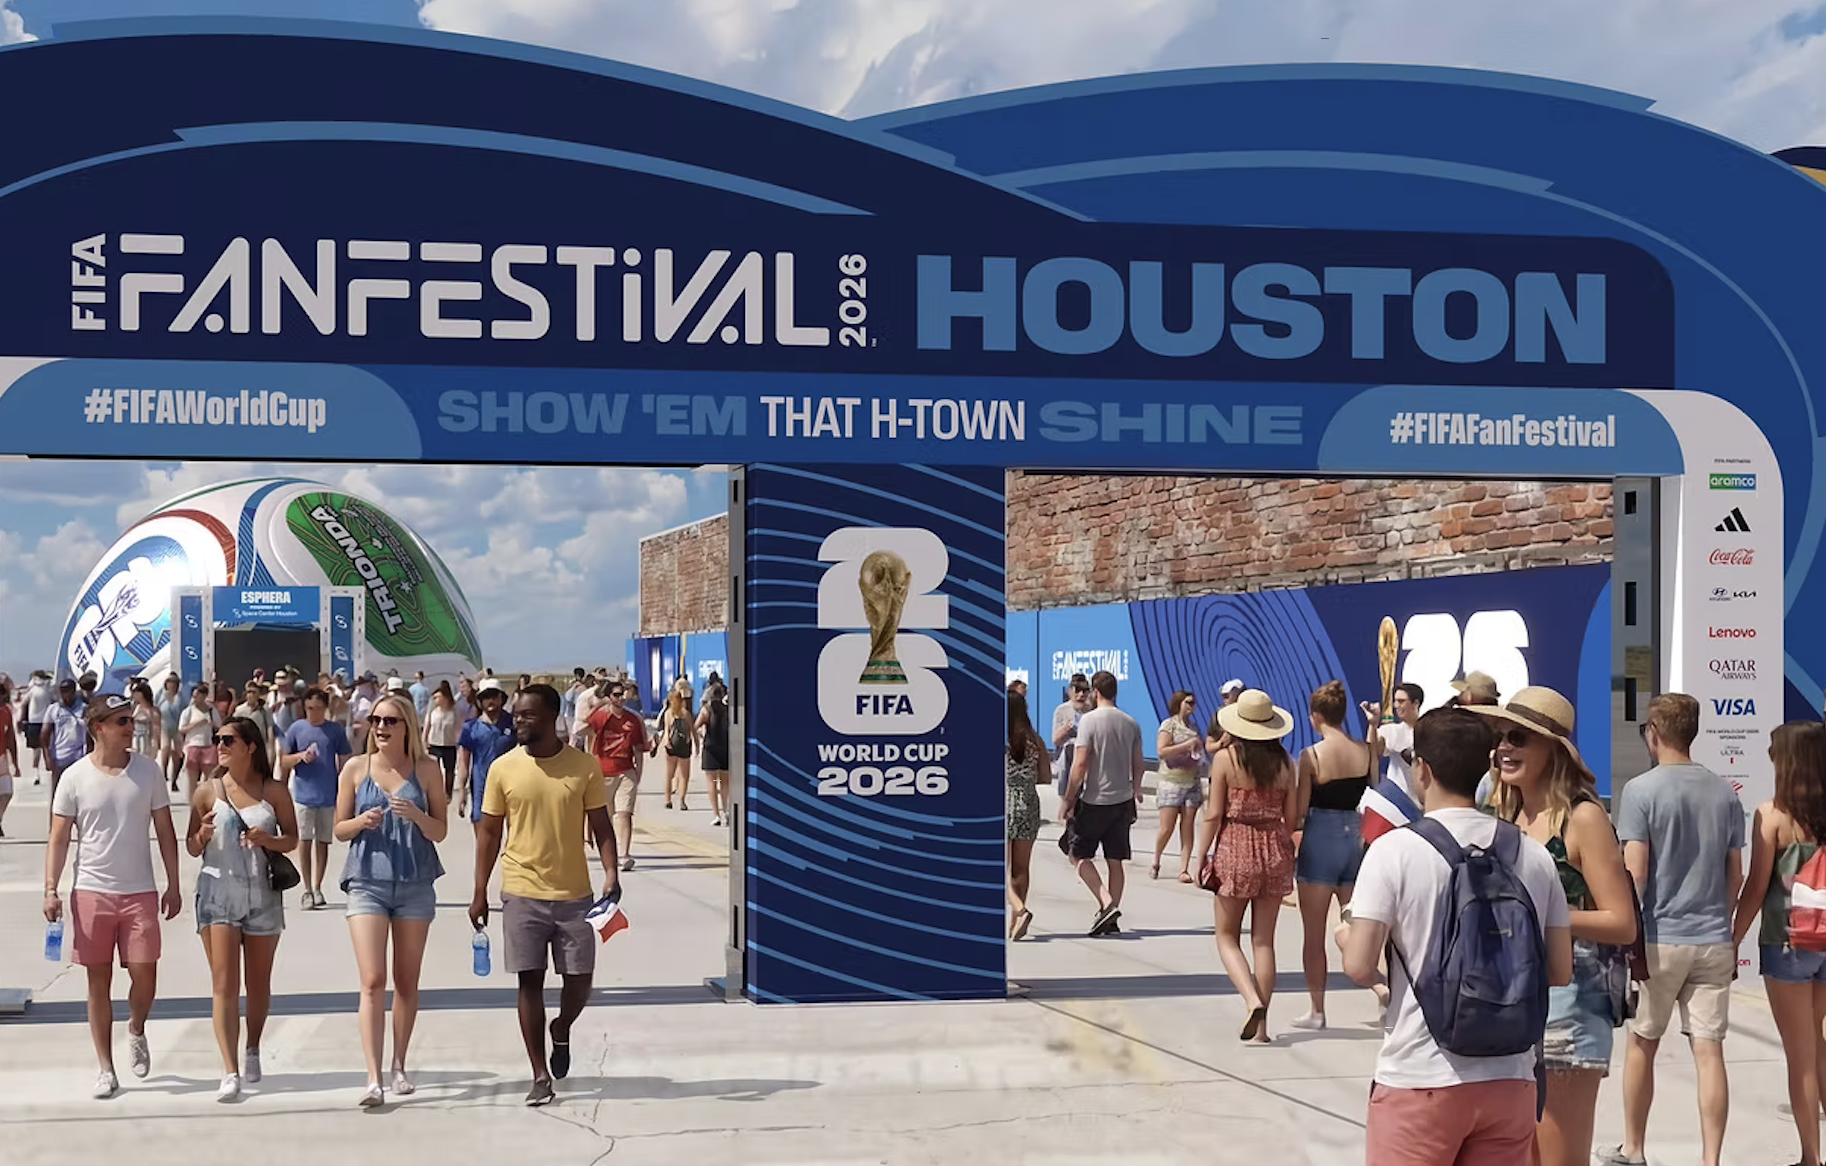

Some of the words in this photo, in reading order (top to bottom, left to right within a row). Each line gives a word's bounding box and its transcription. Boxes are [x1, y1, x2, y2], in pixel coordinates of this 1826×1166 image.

[72, 233, 106, 330] FIFA
[838, 253, 867, 347] 2026
[917, 254, 1606, 364] HOUSTON
[84, 388, 326, 433] #FIFAWorldCup
[437, 389, 629, 434] SHOW
[641, 393, 746, 436] 'EM
[760, 396, 861, 438] THAT
[871, 398, 1025, 440] H-TOWN
[1038, 400, 1303, 445] SHINE
[1390, 412, 1616, 448] #FIFAFanFestival
[1710, 477, 1756, 487] aramco
[311, 505, 402, 635] TRIONDA
[240, 591, 291, 604] ESPHERA
[1709, 626, 1756, 638] Lenovo
[1709, 659, 1756, 673] QATAR
[1721, 672, 1757, 680] AIRWAYS
[856, 695, 914, 715] FIFA
[1710, 698, 1756, 715] VISA
[817, 744, 901, 762] WORLD
[903, 744, 949, 762] CUP
[817, 766, 949, 796] 2026
